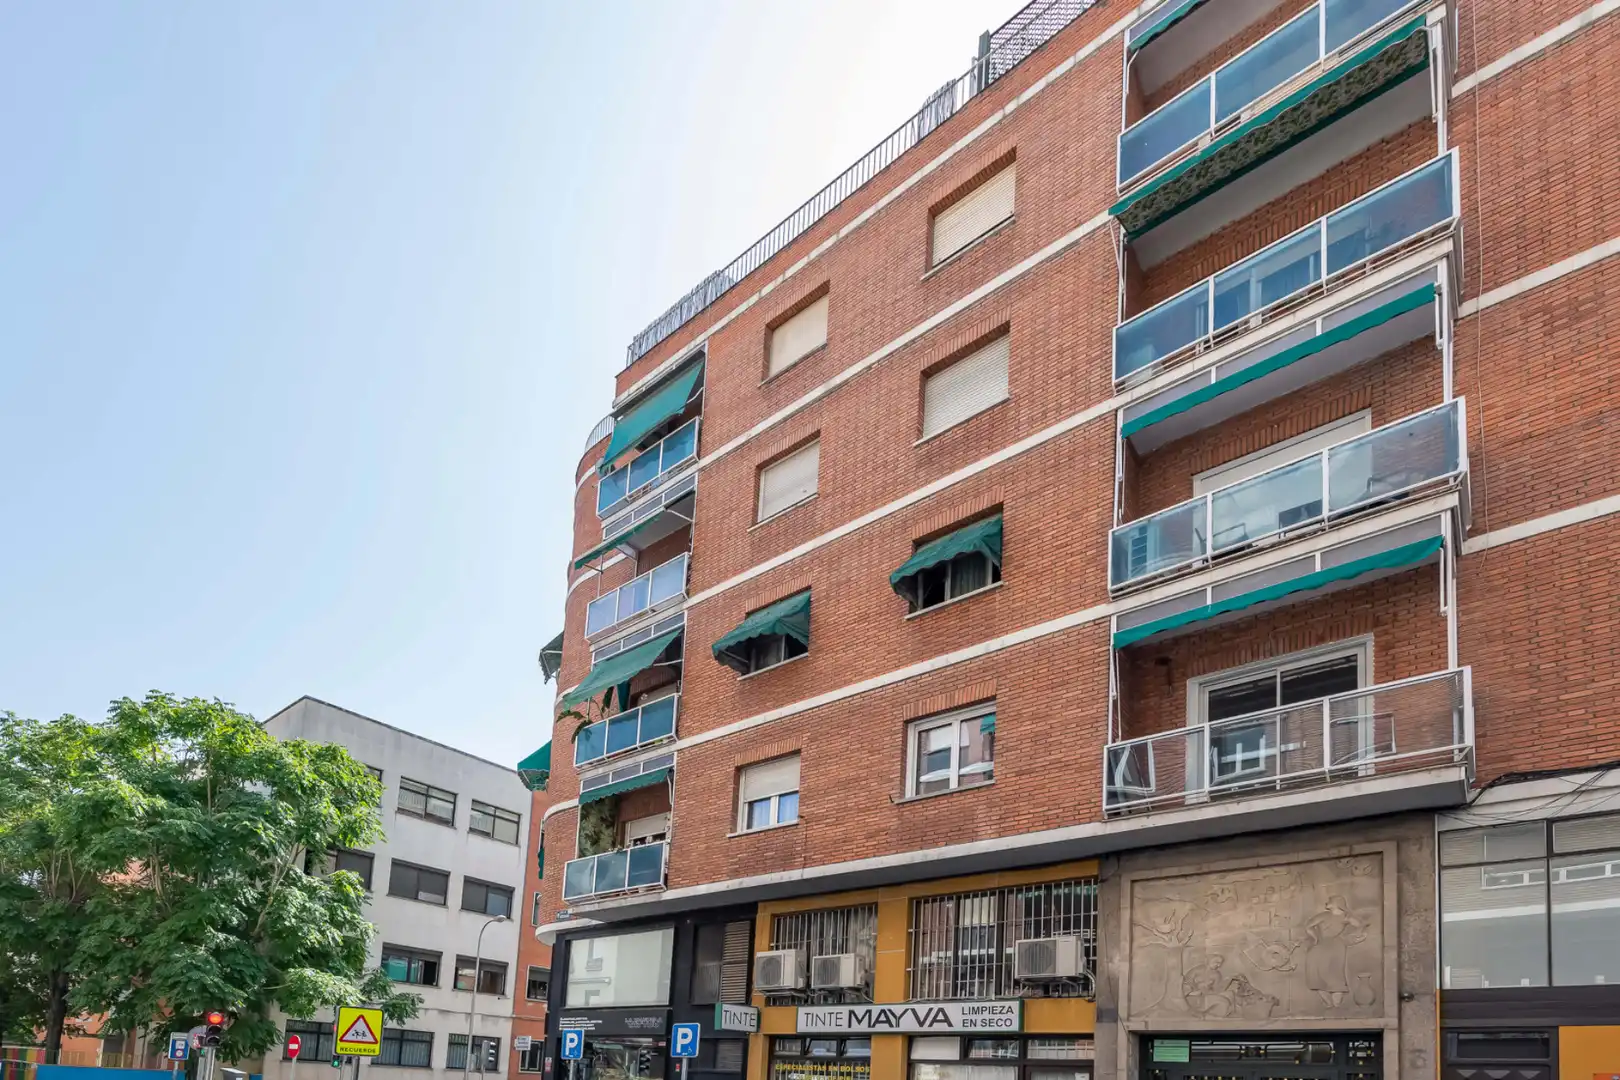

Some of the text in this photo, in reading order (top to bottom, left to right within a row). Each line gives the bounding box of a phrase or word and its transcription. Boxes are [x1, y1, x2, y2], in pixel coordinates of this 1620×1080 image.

[723, 1009, 756, 1027] TINTE
[804, 1007, 954, 1029] TINTE MAYVA
[961, 1005, 1014, 1016] LIMPIEZA
[961, 1017, 1014, 1028] EN SECO
[565, 1032, 579, 1056] P
[676, 1027, 693, 1054] P
[775, 1063, 827, 1071] ESPECIALISTAS
